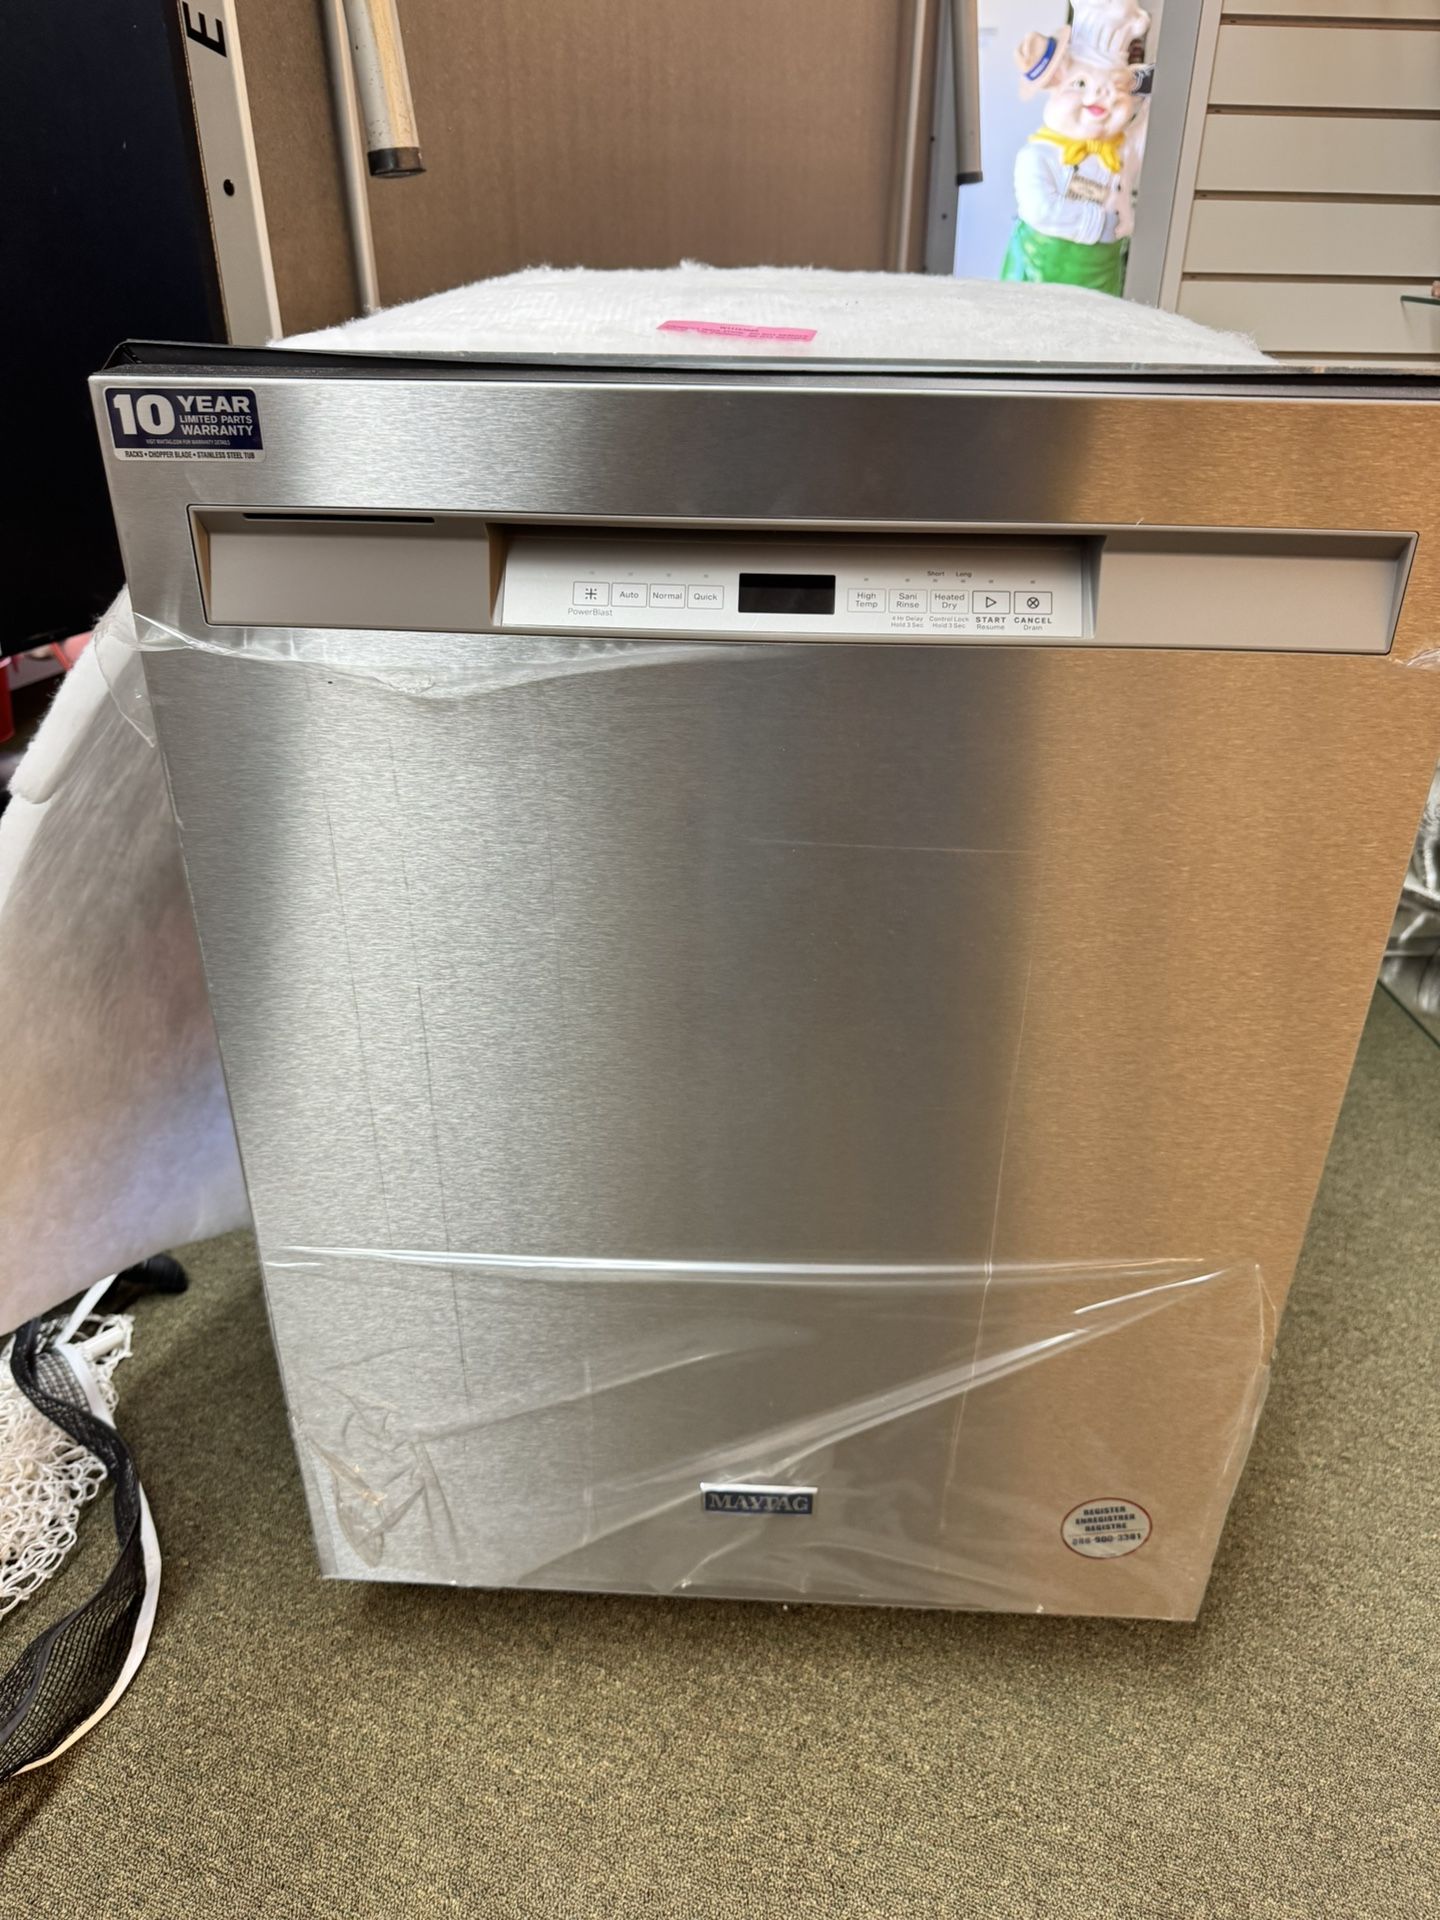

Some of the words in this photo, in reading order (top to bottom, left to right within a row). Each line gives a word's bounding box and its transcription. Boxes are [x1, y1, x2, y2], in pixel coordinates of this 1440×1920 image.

[182, 1, 227, 57] E
[176, 395, 251, 413] YEAR
[113, 393, 176, 435] 10
[179, 414, 218, 424] LIMITED
[221, 415, 253, 424] PARTS
[180, 424, 253, 436] WARRANTY
[125, 450, 144, 458] RACKS
[148, 451, 174, 459] CHOPPER
[175, 451, 192, 459] BLADE
[197, 451, 226, 459] STAINLESS
[227, 451, 243, 459] STEEL
[619, 591, 639, 599] Auto
[652, 591, 682, 600] Normal
[693, 592, 718, 601] Quick
[857, 592, 876, 601] High
[898, 592, 918, 600] Sani
[934, 593, 965, 601] Heated
[855, 600, 878, 609] Temp
[896, 601, 920, 609] Rinse
[941, 601, 958, 610] Dry
[567, 607, 613, 617] PowerBlast
[709, 1493, 809, 1512] MAYTAG
[1083, 1506, 1126, 1515] REGISTER
[1075, 1513, 1135, 1525] ENREGISTRER
